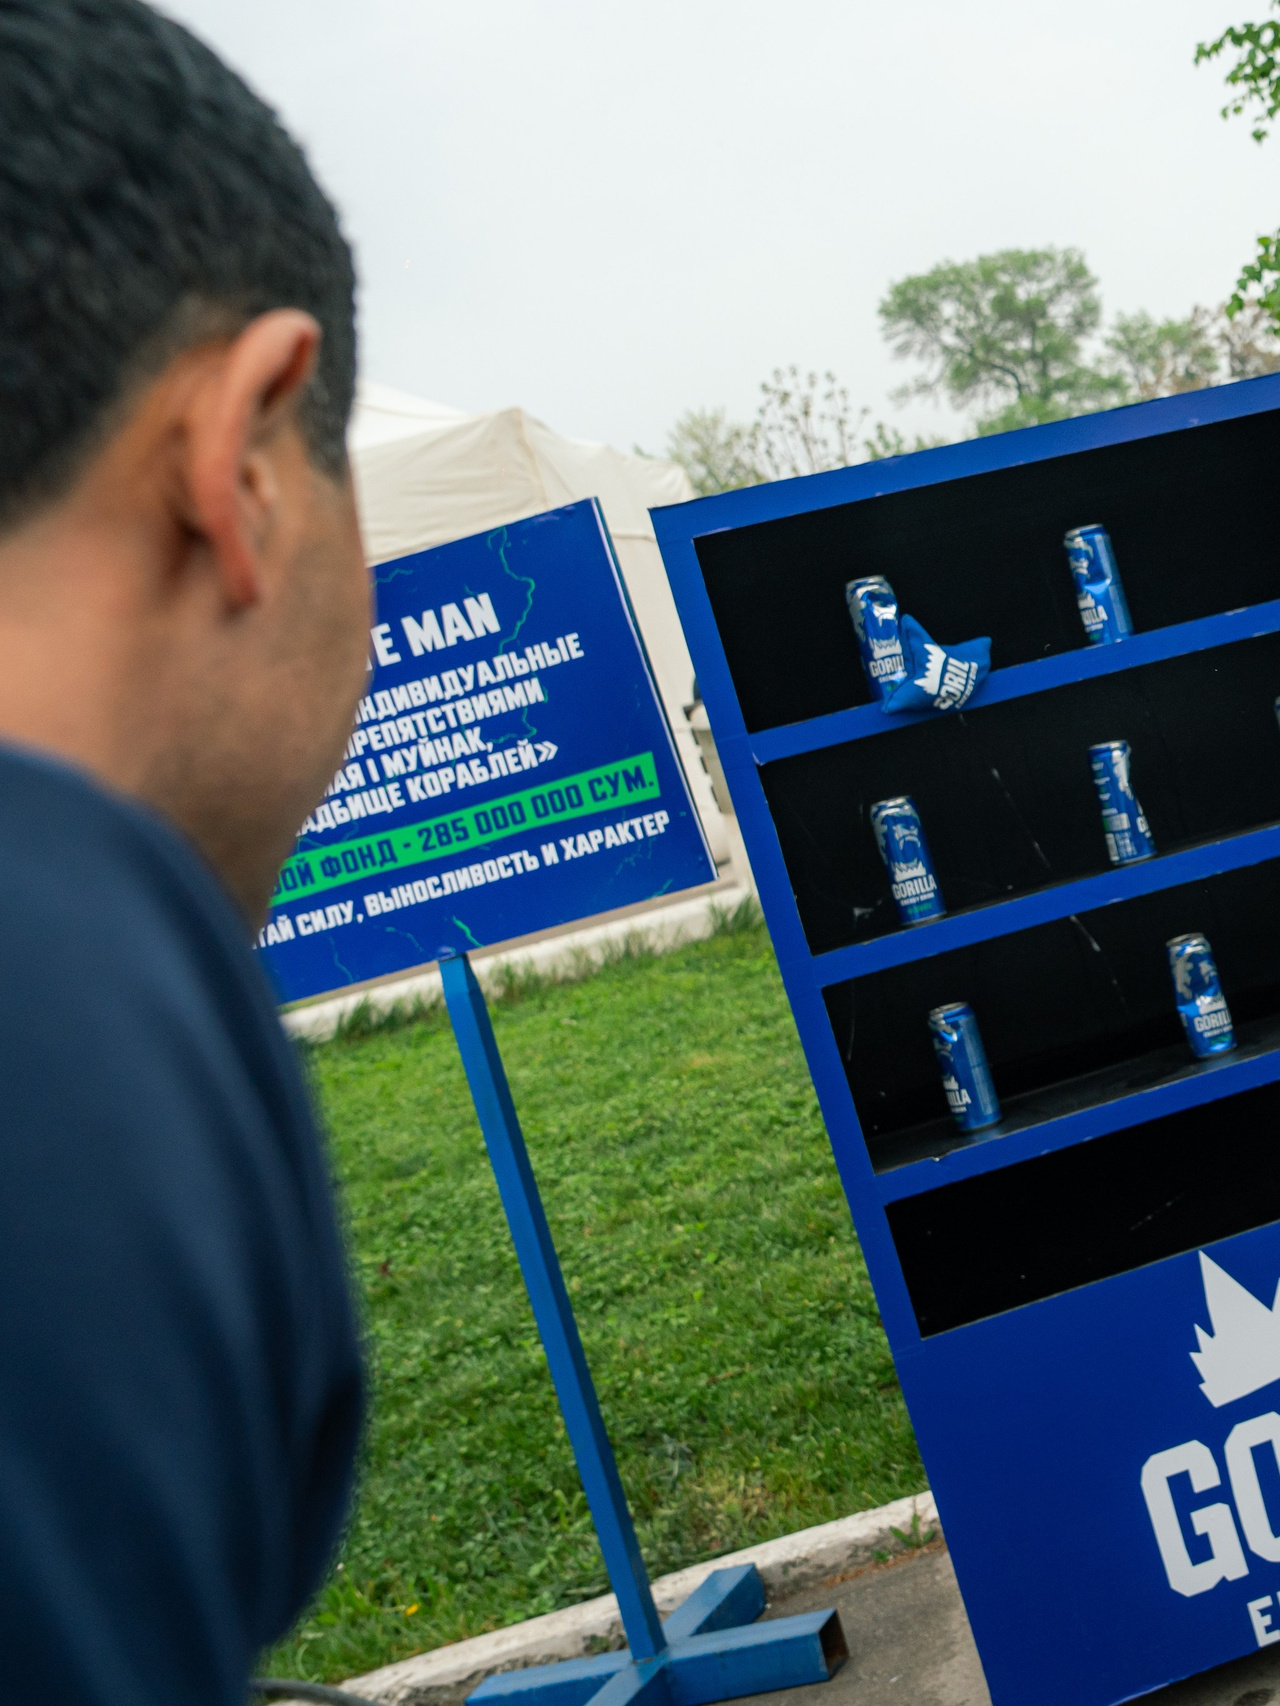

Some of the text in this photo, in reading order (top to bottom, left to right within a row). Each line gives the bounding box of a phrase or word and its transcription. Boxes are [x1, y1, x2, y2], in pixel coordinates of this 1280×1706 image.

[366, 592, 501, 671] E MAN
[296, 739, 559, 837] АДБИЩЕ КОРАБЛЕЙ»
[380, 726, 494, 780] МУЙНАК,
[272, 857, 317, 896] ОЙ
[320, 838, 398, 879] ФОНД
[417, 816, 471, 853] 285
[473, 801, 528, 837] 000
[530, 783, 585, 820] 000
[588, 764, 655, 801] СУМ.
[252, 809, 670, 951] ТАЙ СИЛУ, ВЫНОСЛИВОСТЬ И ХАРАКТЕР
[891, 873, 937, 900] GORILLA
